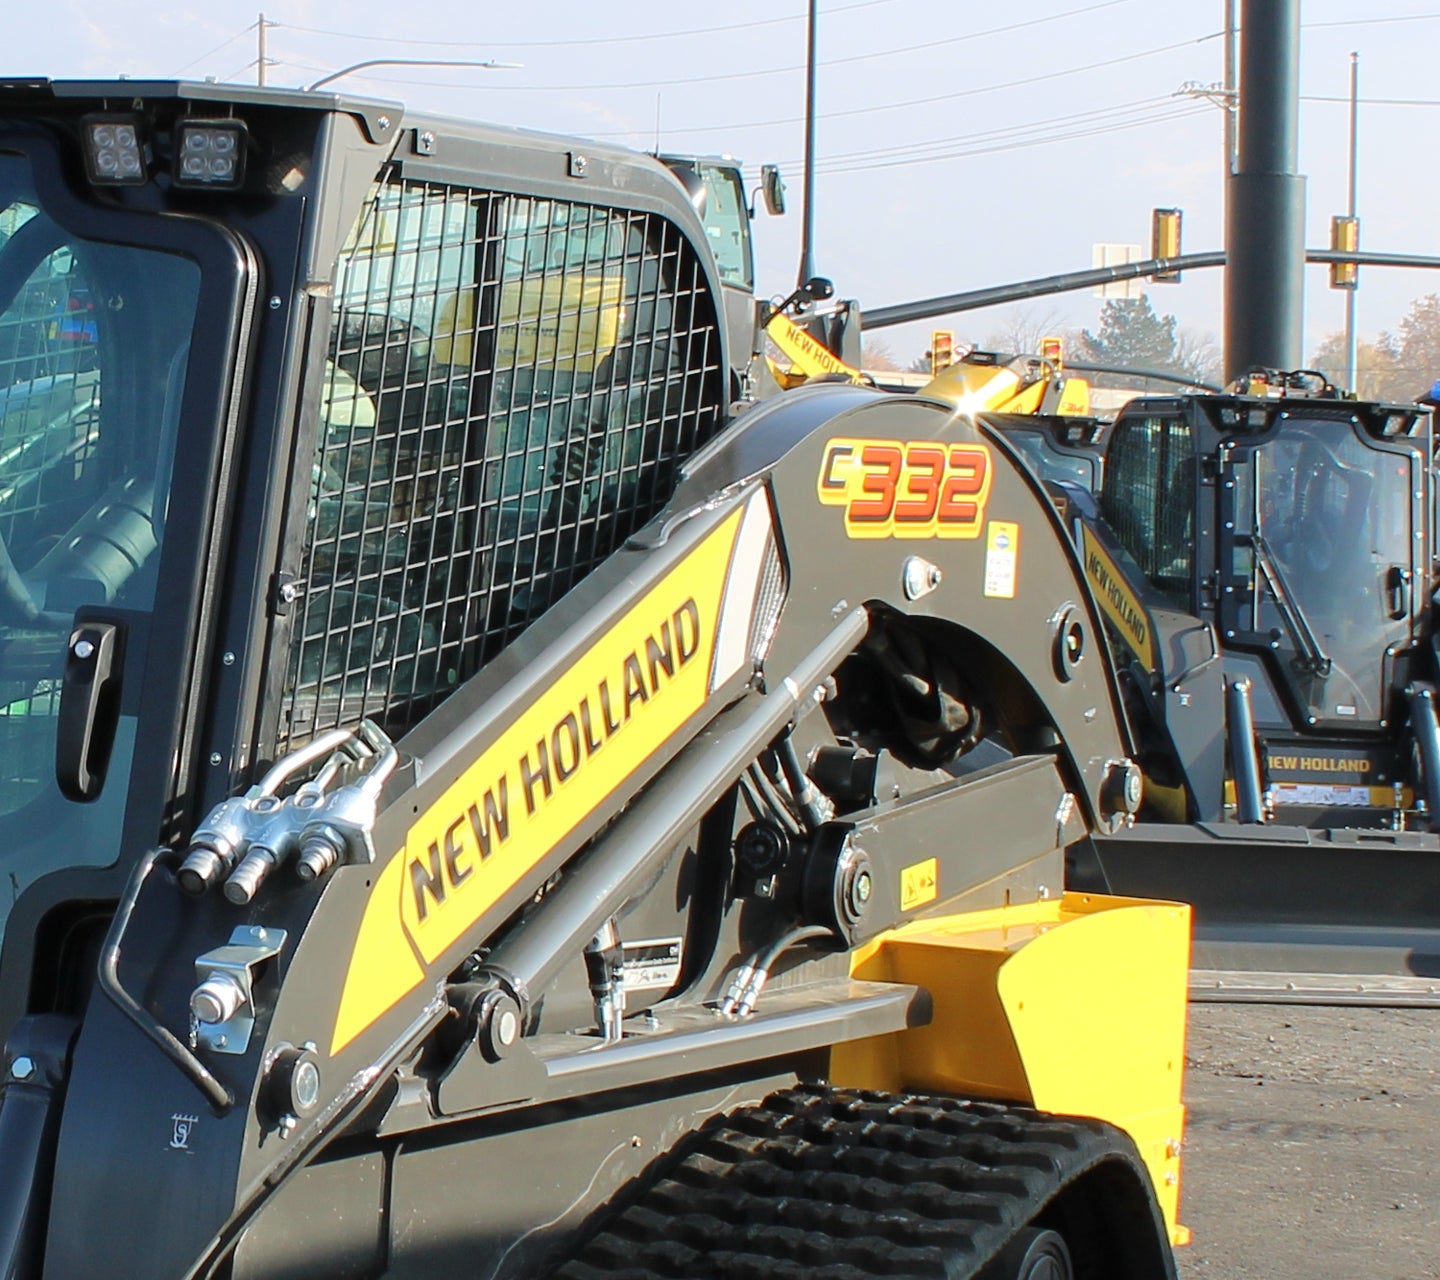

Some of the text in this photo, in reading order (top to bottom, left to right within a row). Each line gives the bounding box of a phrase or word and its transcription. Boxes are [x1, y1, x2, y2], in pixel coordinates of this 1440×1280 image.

[821, 444, 989, 525] C332
[1088, 552, 1145, 645] NEW HOLLAND
[409, 597, 700, 924] NEW HOLLAND
[1300, 757, 1371, 773] HOLLAND
